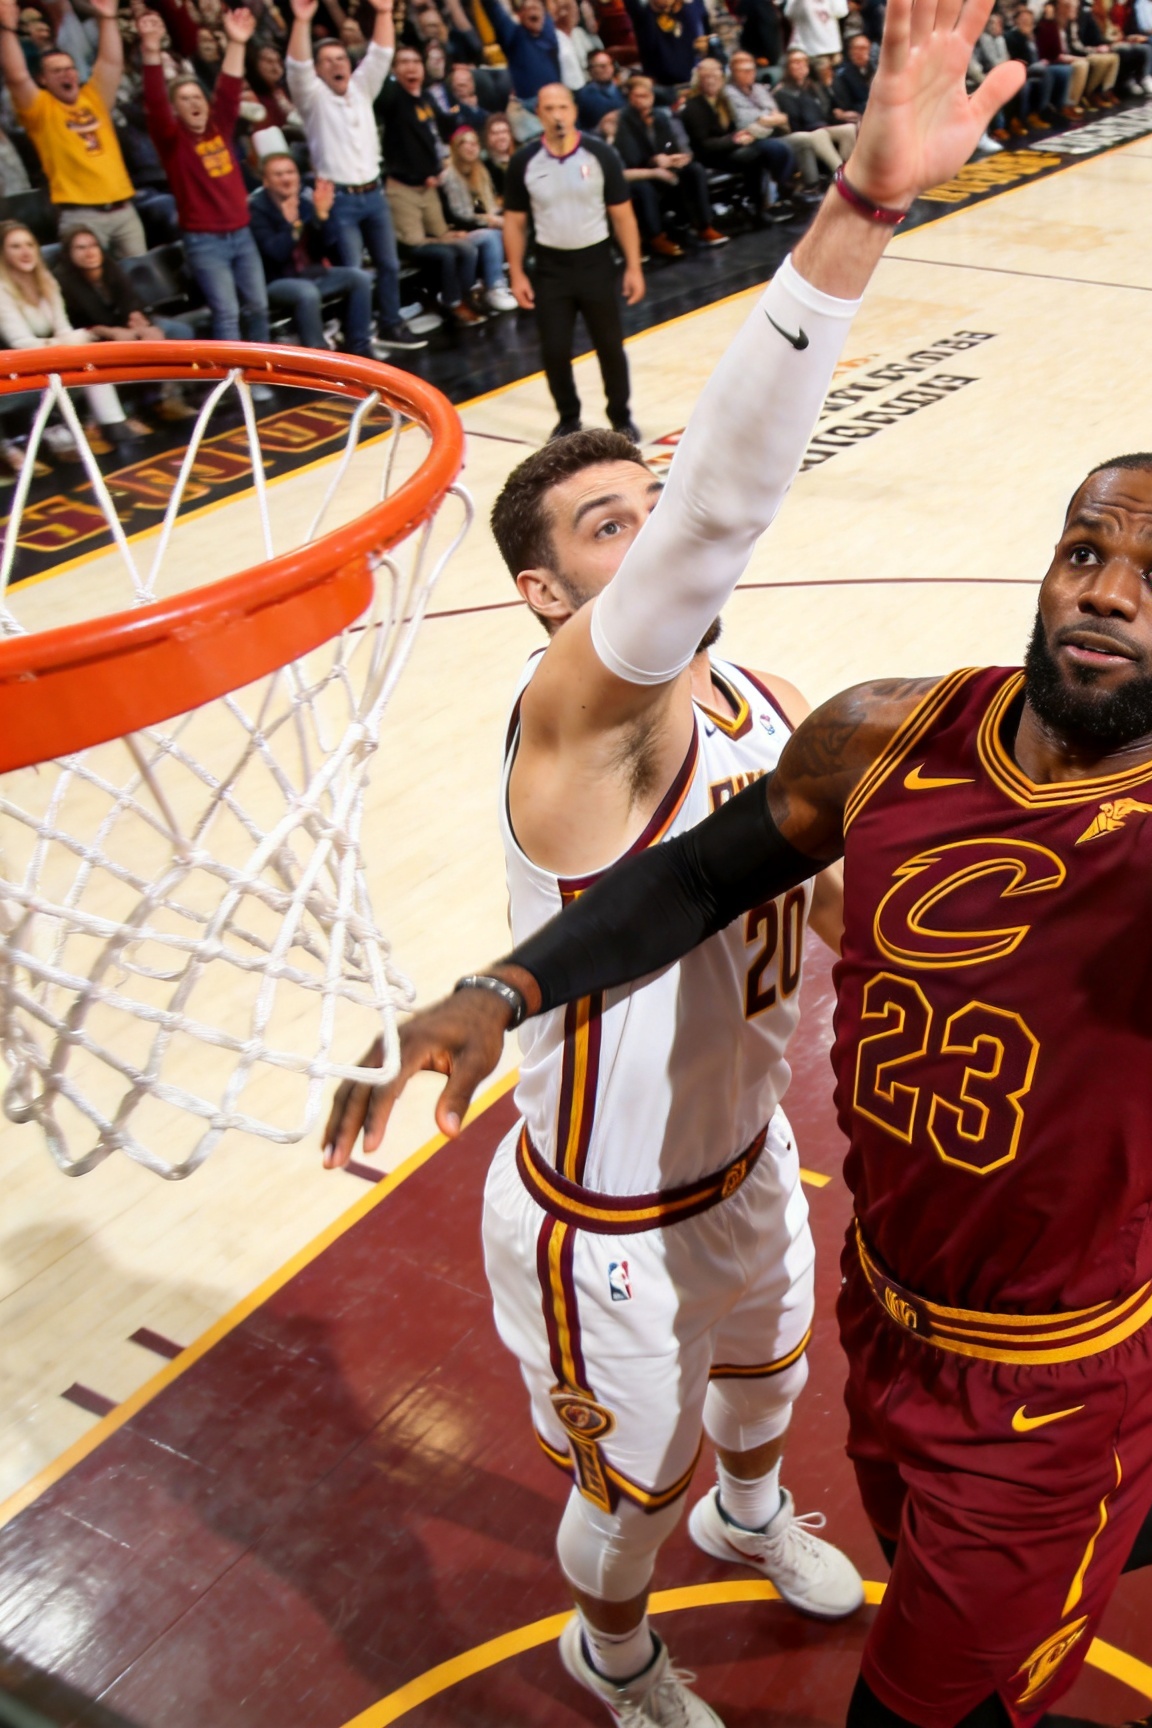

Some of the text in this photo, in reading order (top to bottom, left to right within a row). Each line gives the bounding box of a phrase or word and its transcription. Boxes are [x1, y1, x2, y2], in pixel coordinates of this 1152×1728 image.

[743, 884, 807, 1022] 20
[873, 837, 1066, 969] C
[853, 970, 1041, 1176] 23
